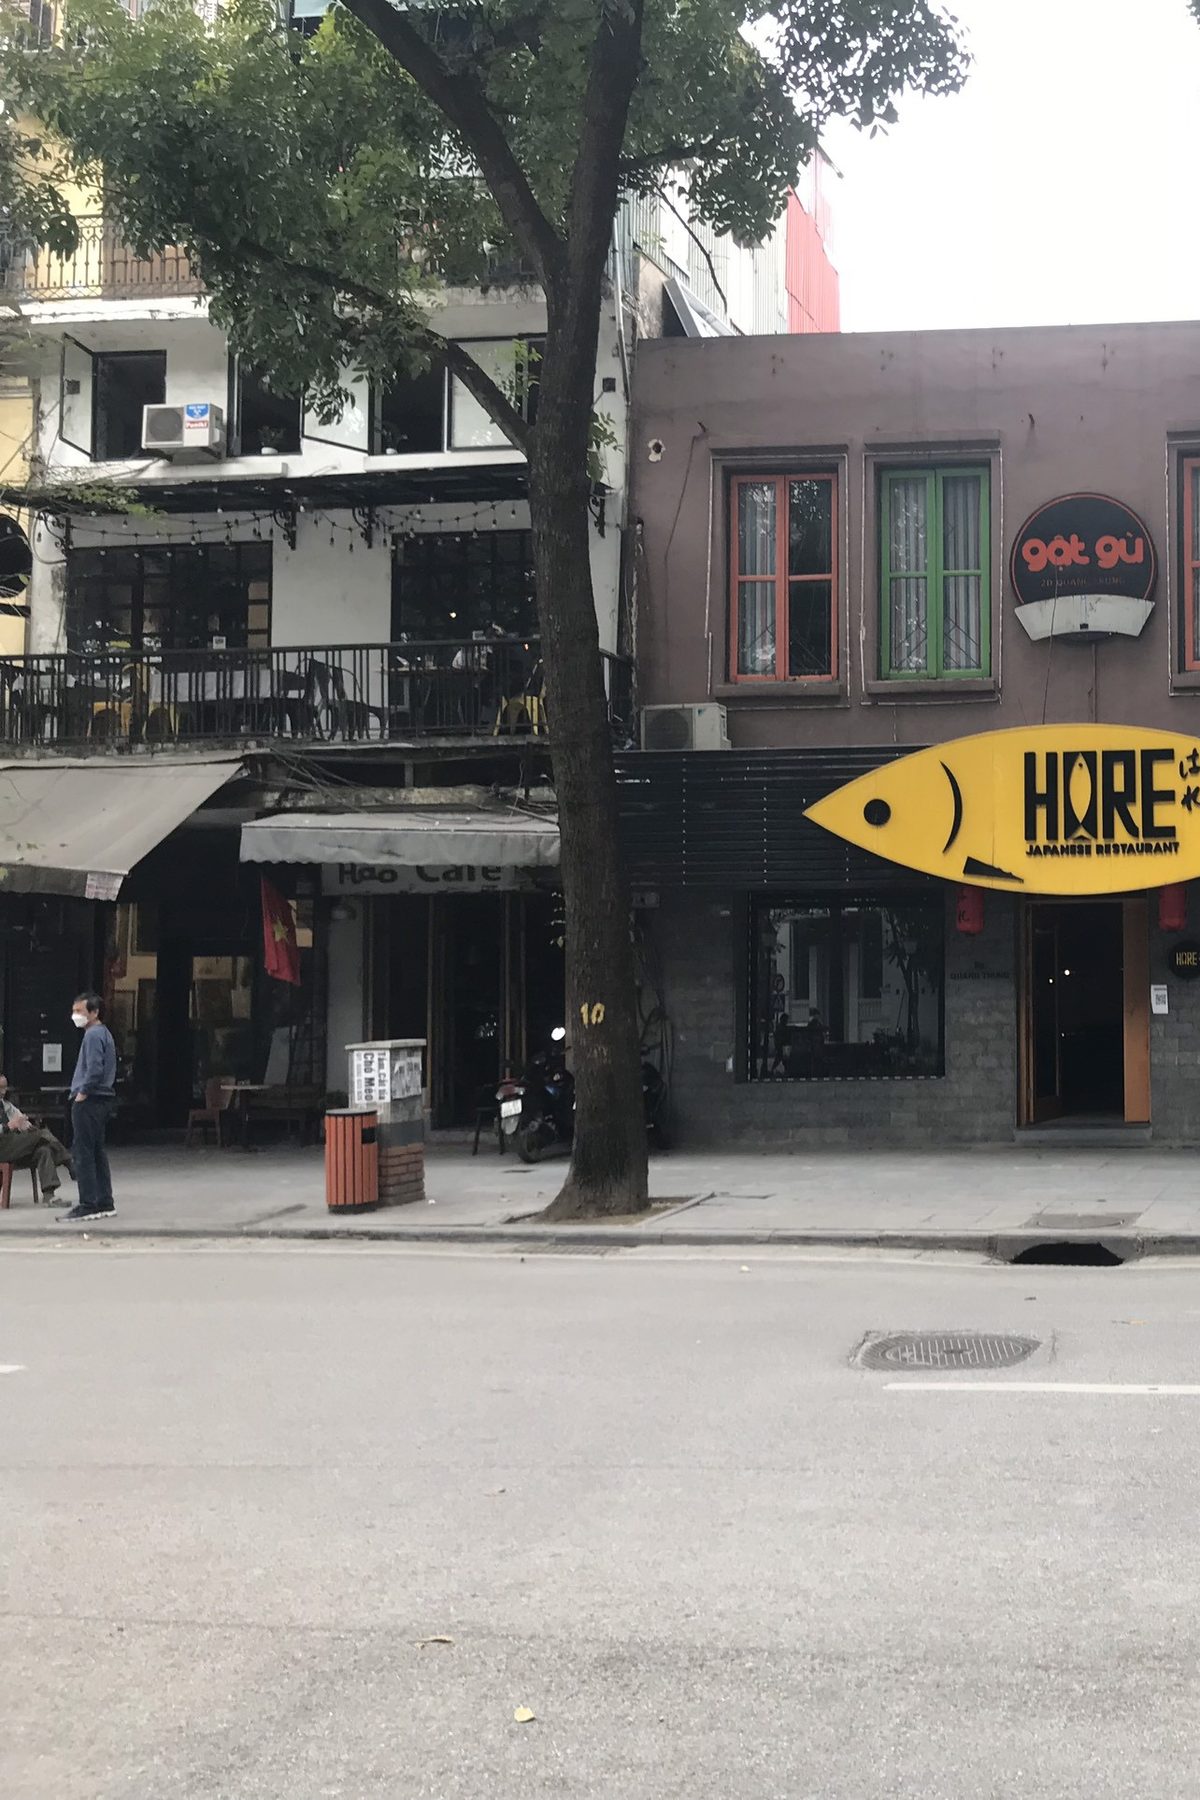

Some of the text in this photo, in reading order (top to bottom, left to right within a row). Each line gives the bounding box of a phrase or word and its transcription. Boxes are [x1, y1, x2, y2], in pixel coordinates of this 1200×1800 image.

[1095, 531, 1144, 569] gù
[1026, 841, 1180, 857] JAPANESE RESTAURANT
[580, 1002, 605, 1025] 10
